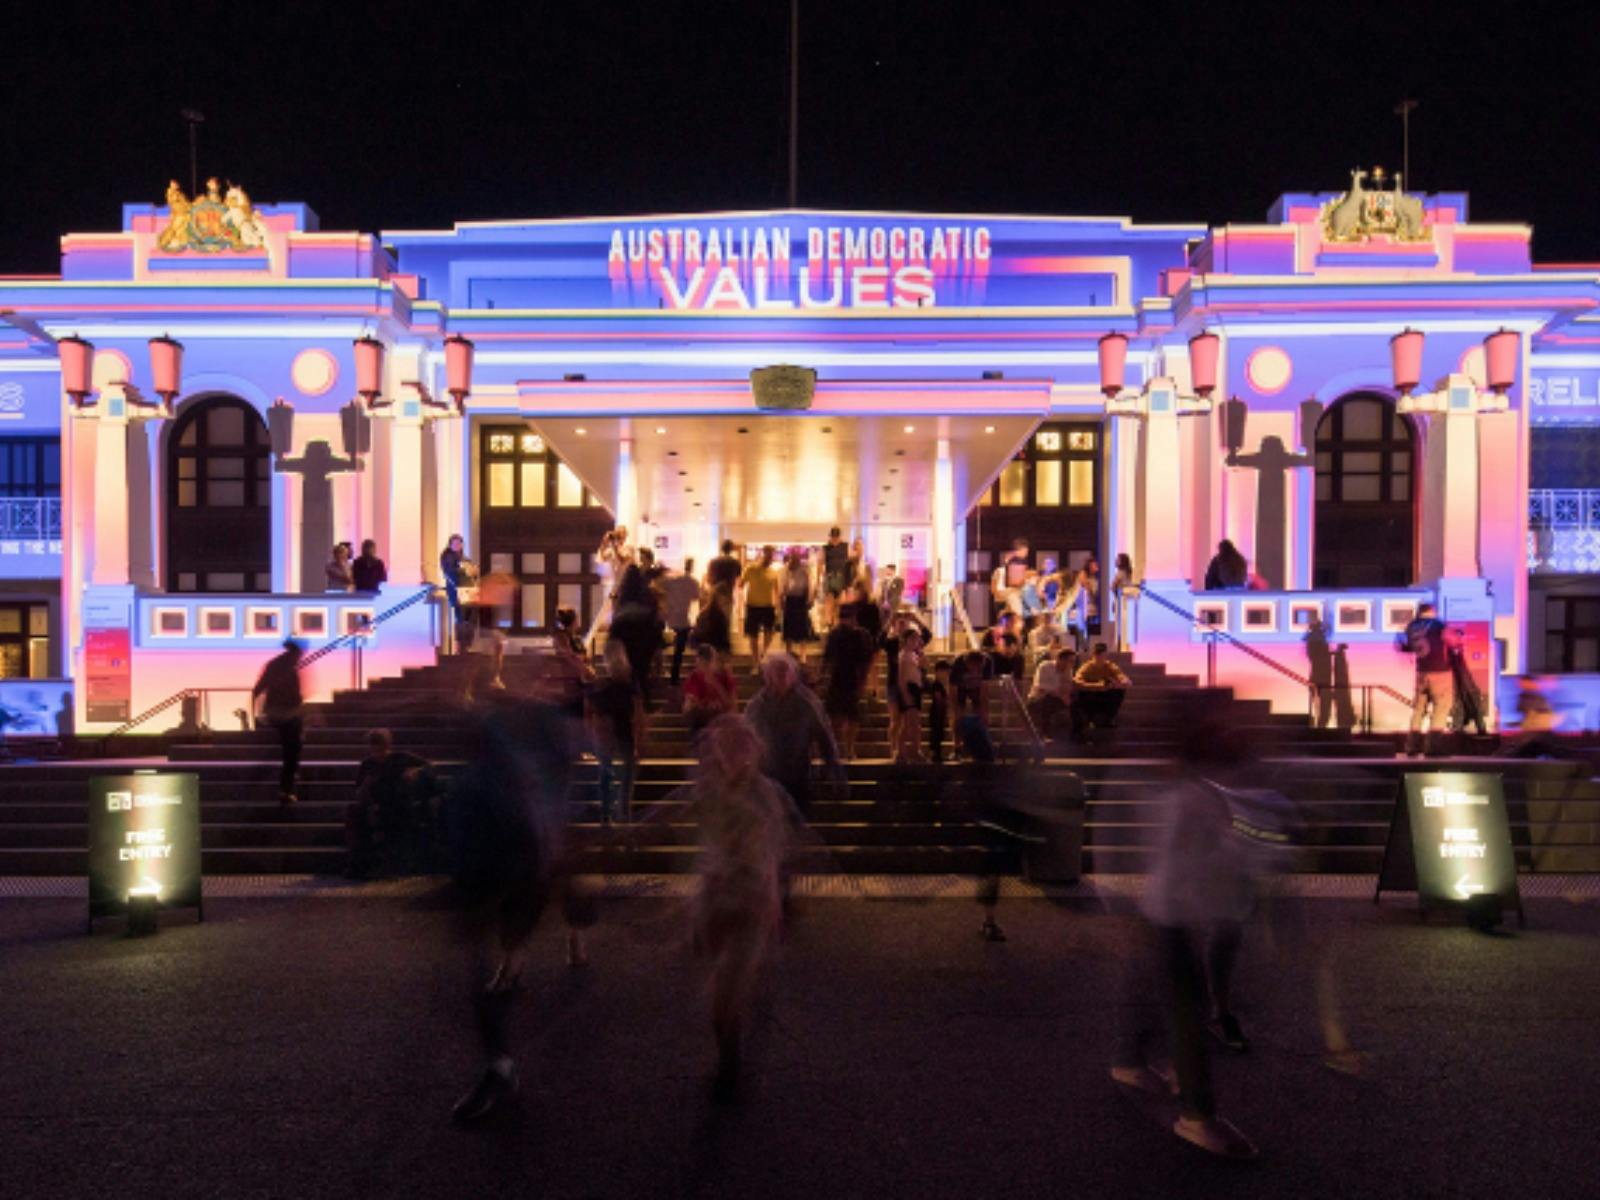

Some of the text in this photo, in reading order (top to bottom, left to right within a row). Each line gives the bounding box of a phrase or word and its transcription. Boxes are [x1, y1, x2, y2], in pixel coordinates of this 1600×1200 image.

[608, 226, 991, 262] AUSTRALIAN DEMOCRATIC
[659, 266, 936, 309] VALUES
[119, 844, 172, 861] ENTRY
